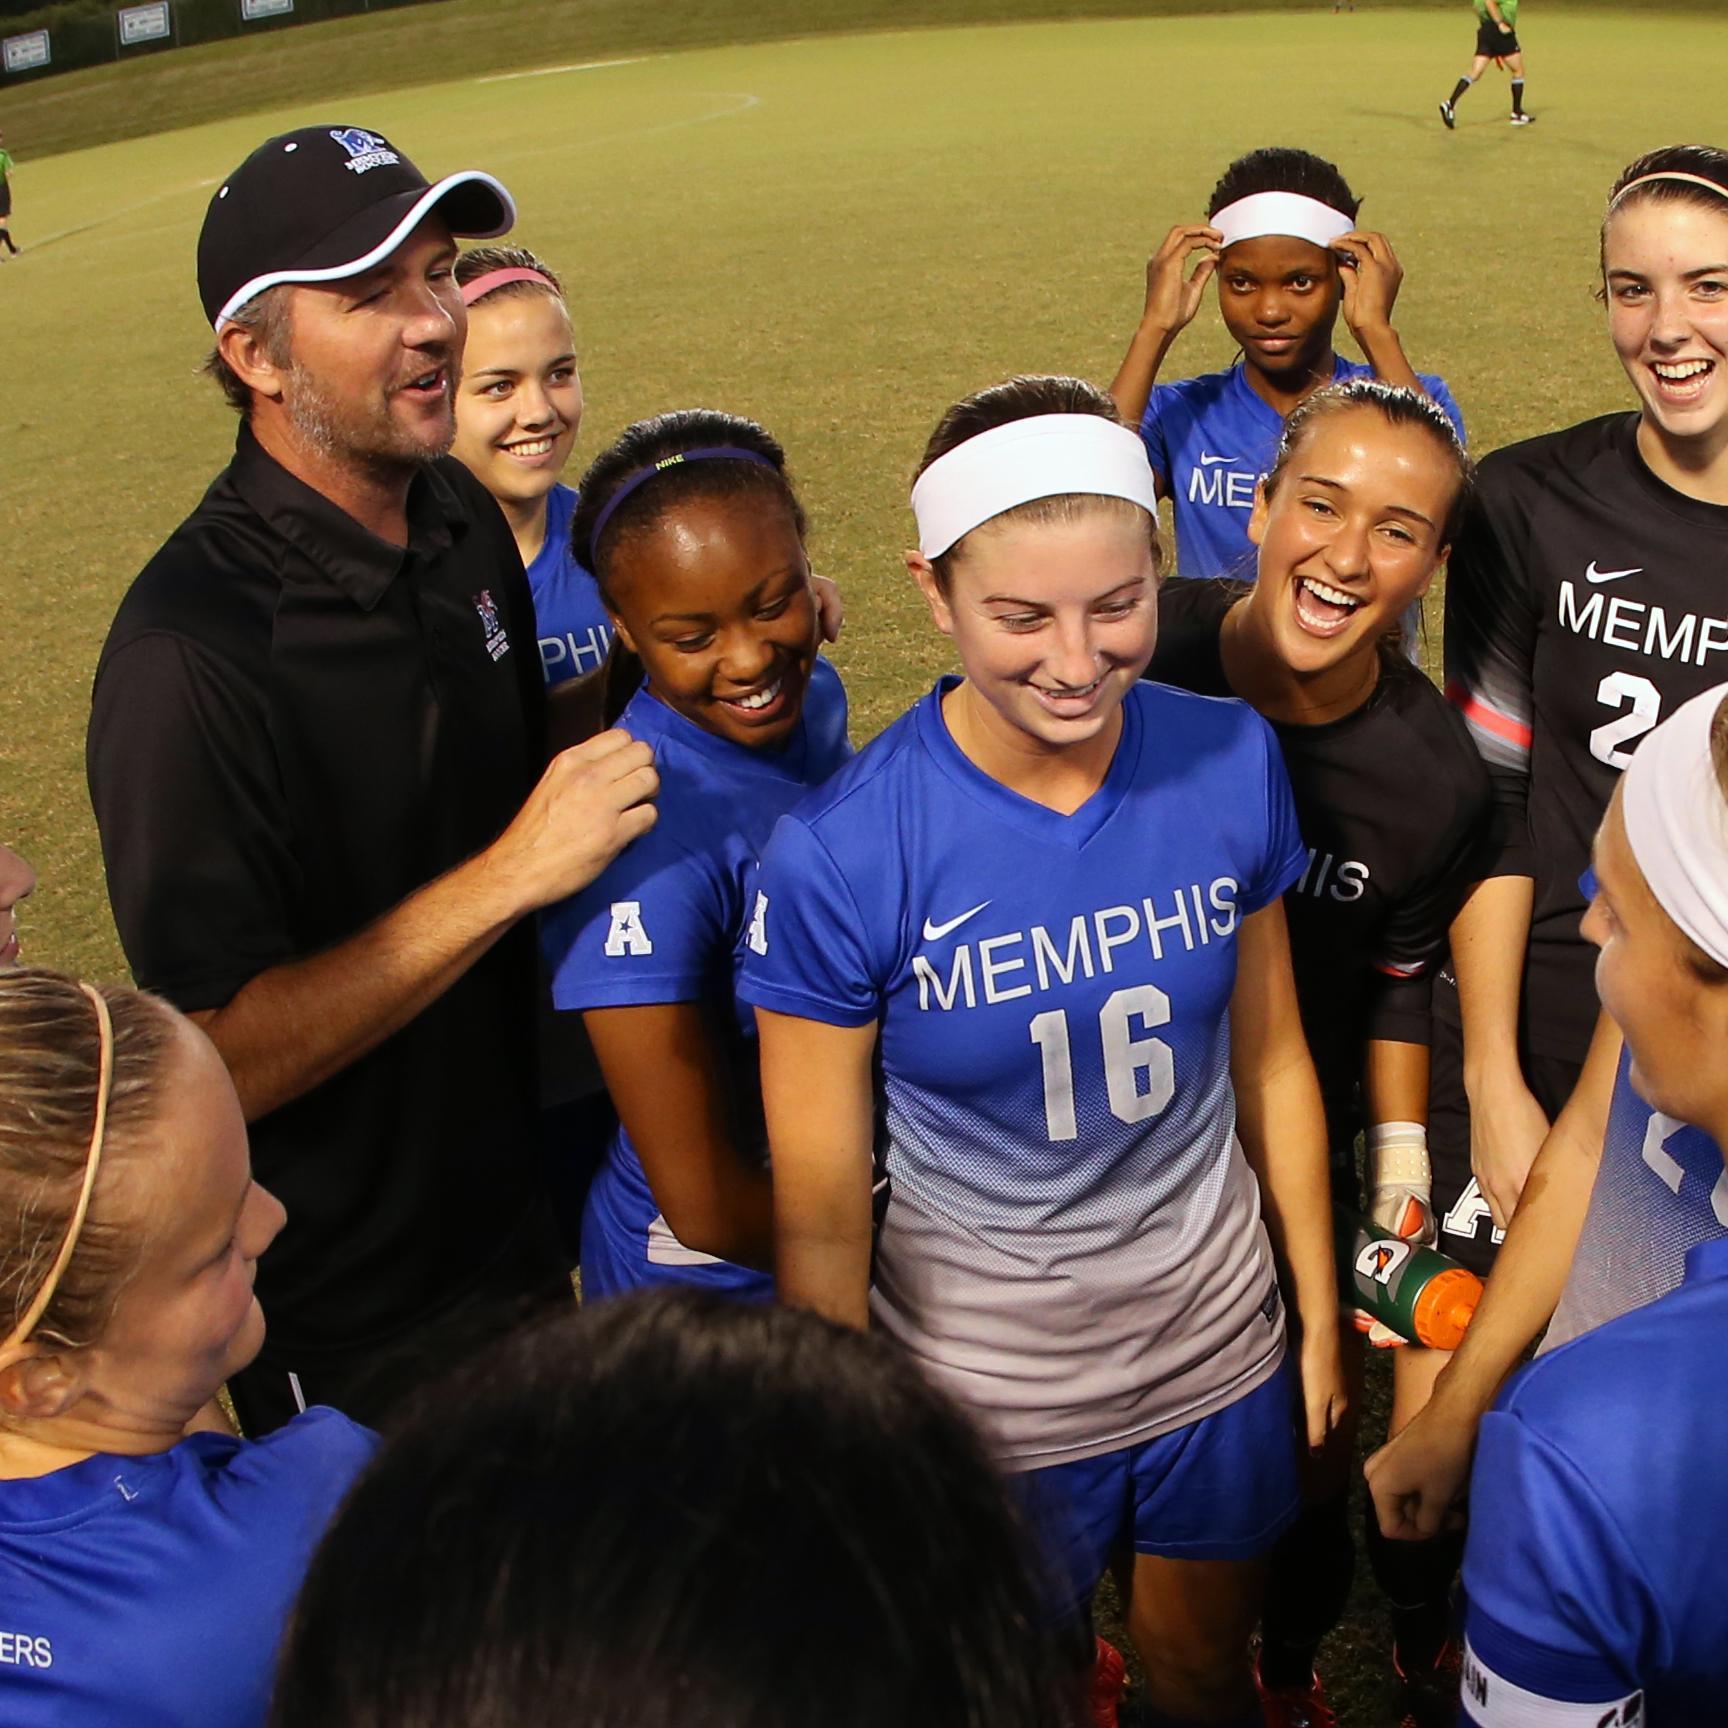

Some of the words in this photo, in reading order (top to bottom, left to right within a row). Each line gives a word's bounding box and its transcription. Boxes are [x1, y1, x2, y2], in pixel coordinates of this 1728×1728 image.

[655, 453, 685, 471] NIKE
[1188, 466, 1269, 508] ME
[538, 624, 614, 683] PHI
[1589, 670, 1662, 771] 2
[604, 900, 654, 957] A
[911, 876, 1239, 1012] MEMPHIS
[1028, 984, 1175, 1142] 16
[0, 1631, 53, 1669] ERS
